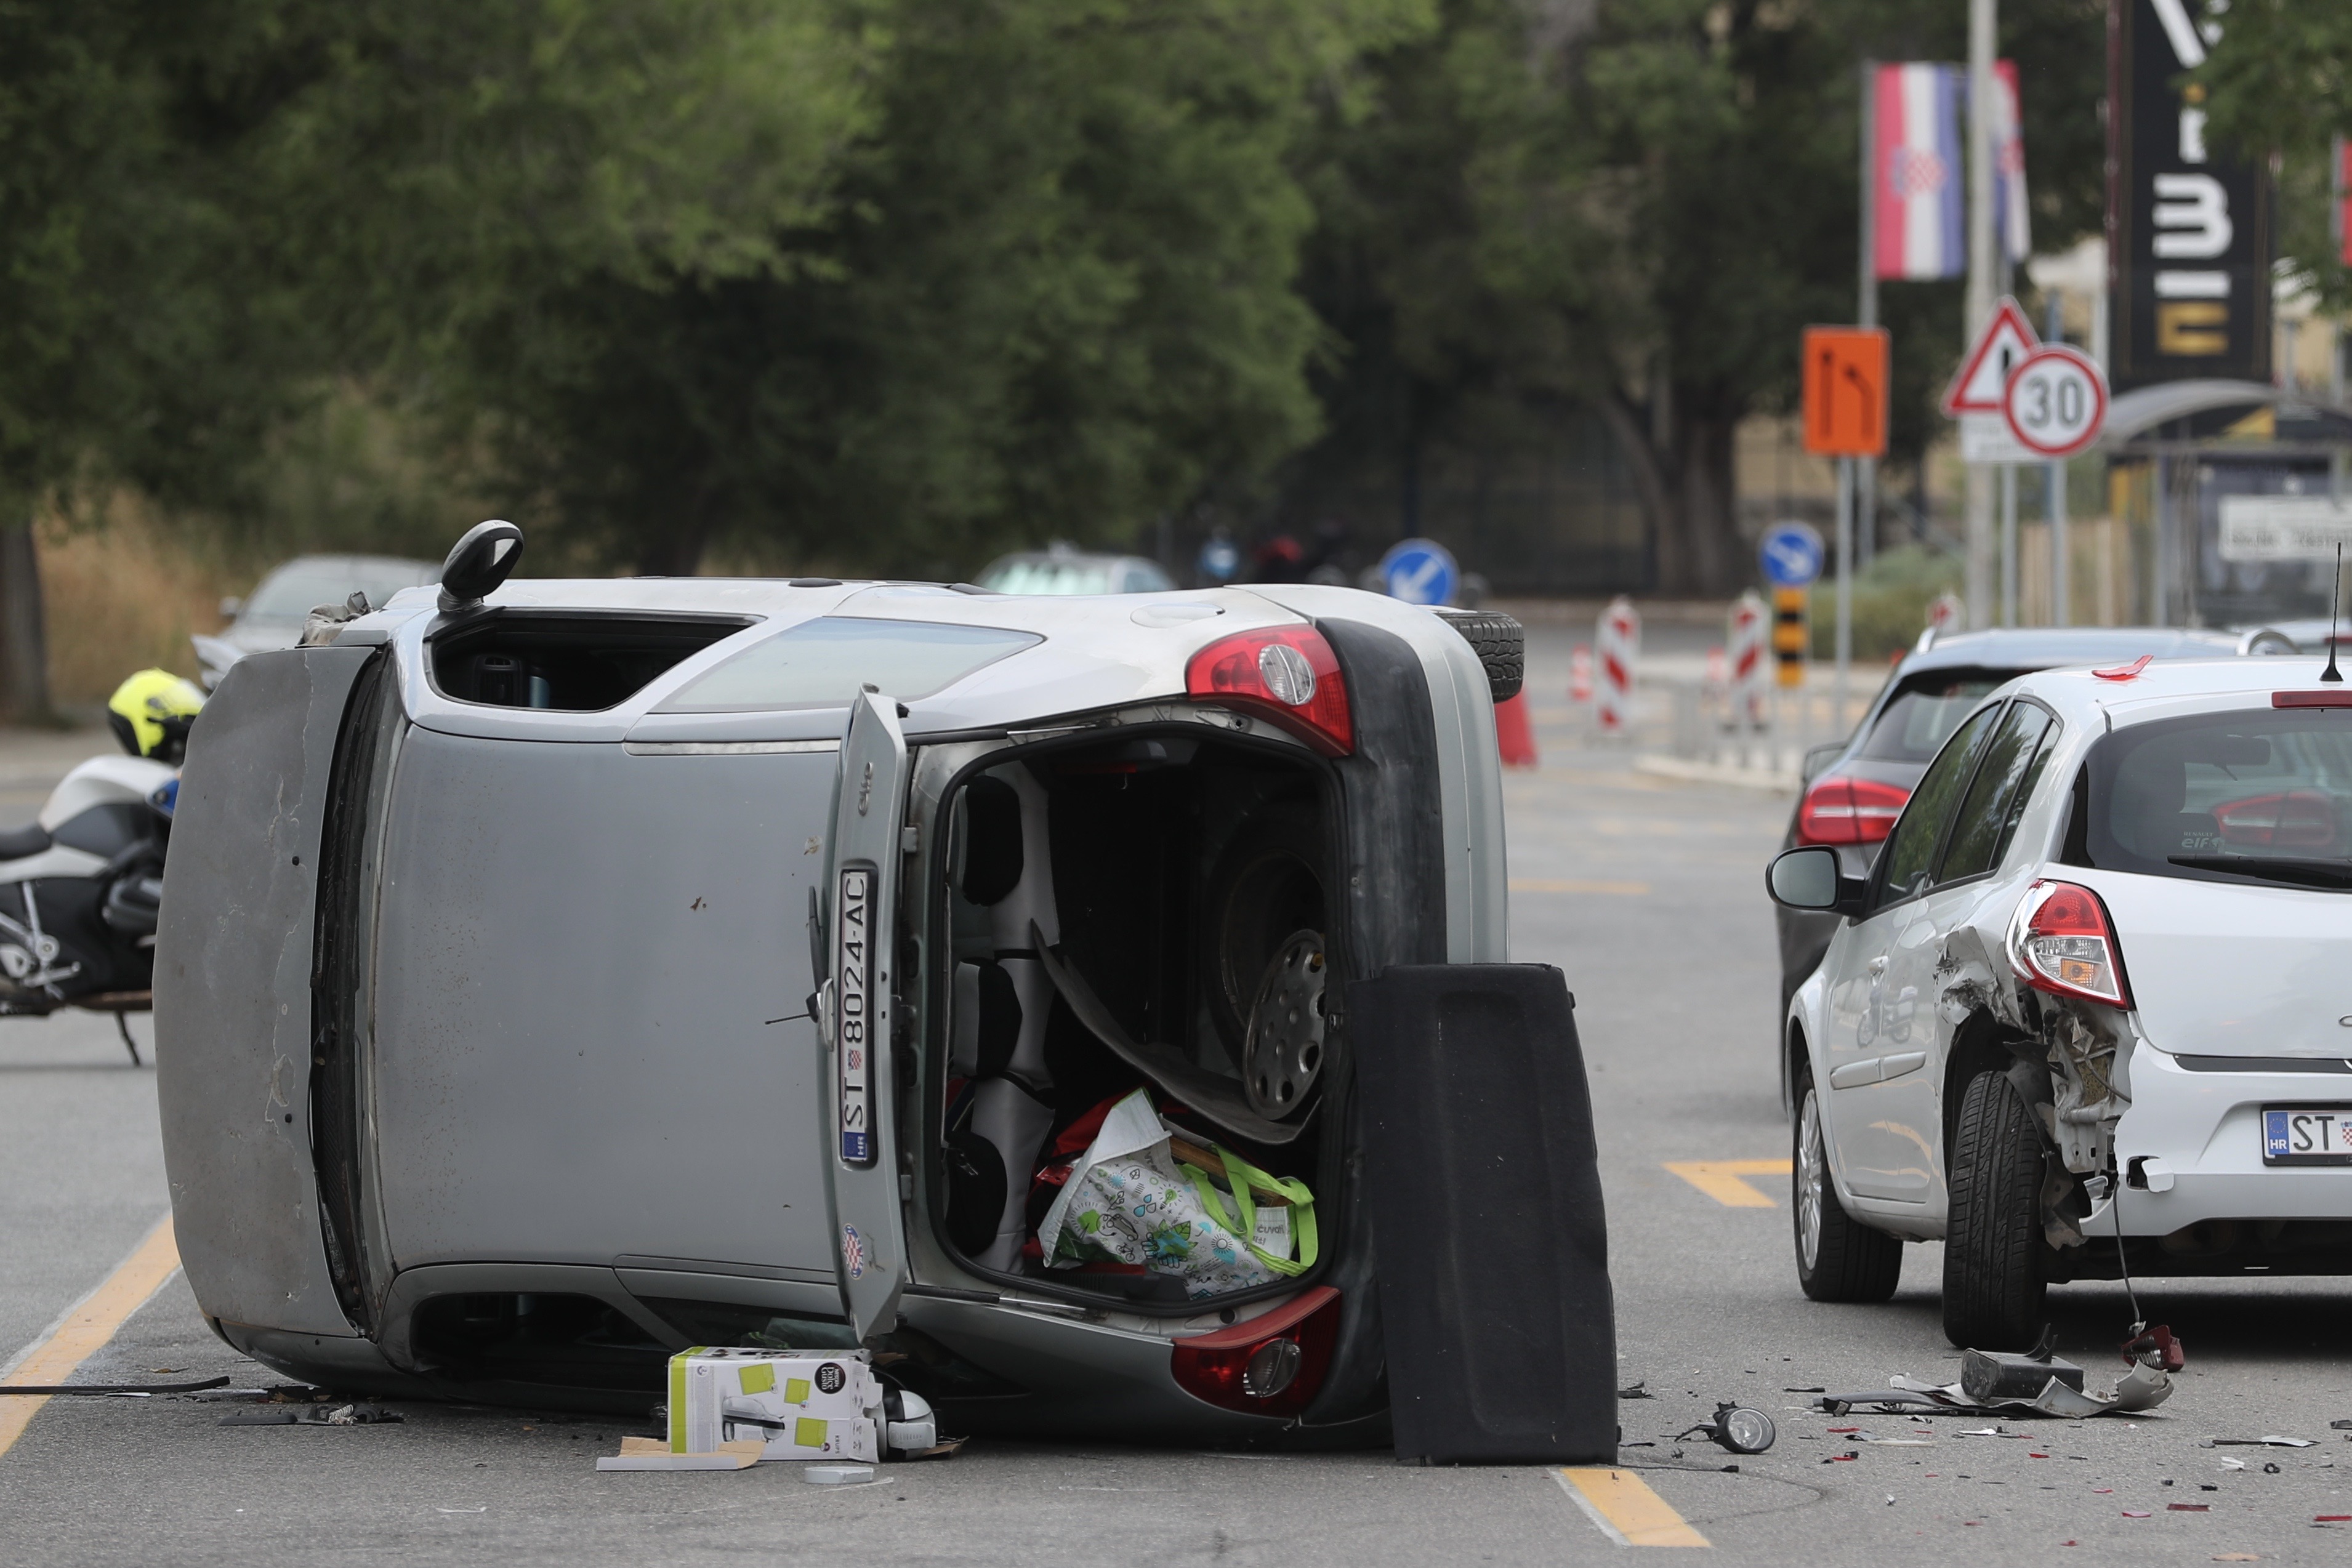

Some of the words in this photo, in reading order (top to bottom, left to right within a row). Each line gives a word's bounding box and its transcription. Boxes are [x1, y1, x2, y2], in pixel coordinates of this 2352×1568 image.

[2025, 375, 2085, 428] 30
[2181, 837, 2210, 848] elf
[844, 877, 864, 1044] 8024-AC
[844, 1077, 863, 1127] ST
[856, 1135, 864, 1156] HR
[2270, 1140, 2287, 1149] HR
[2292, 1116, 2335, 1151] ST
[827, 1367, 835, 1389] Dolce
